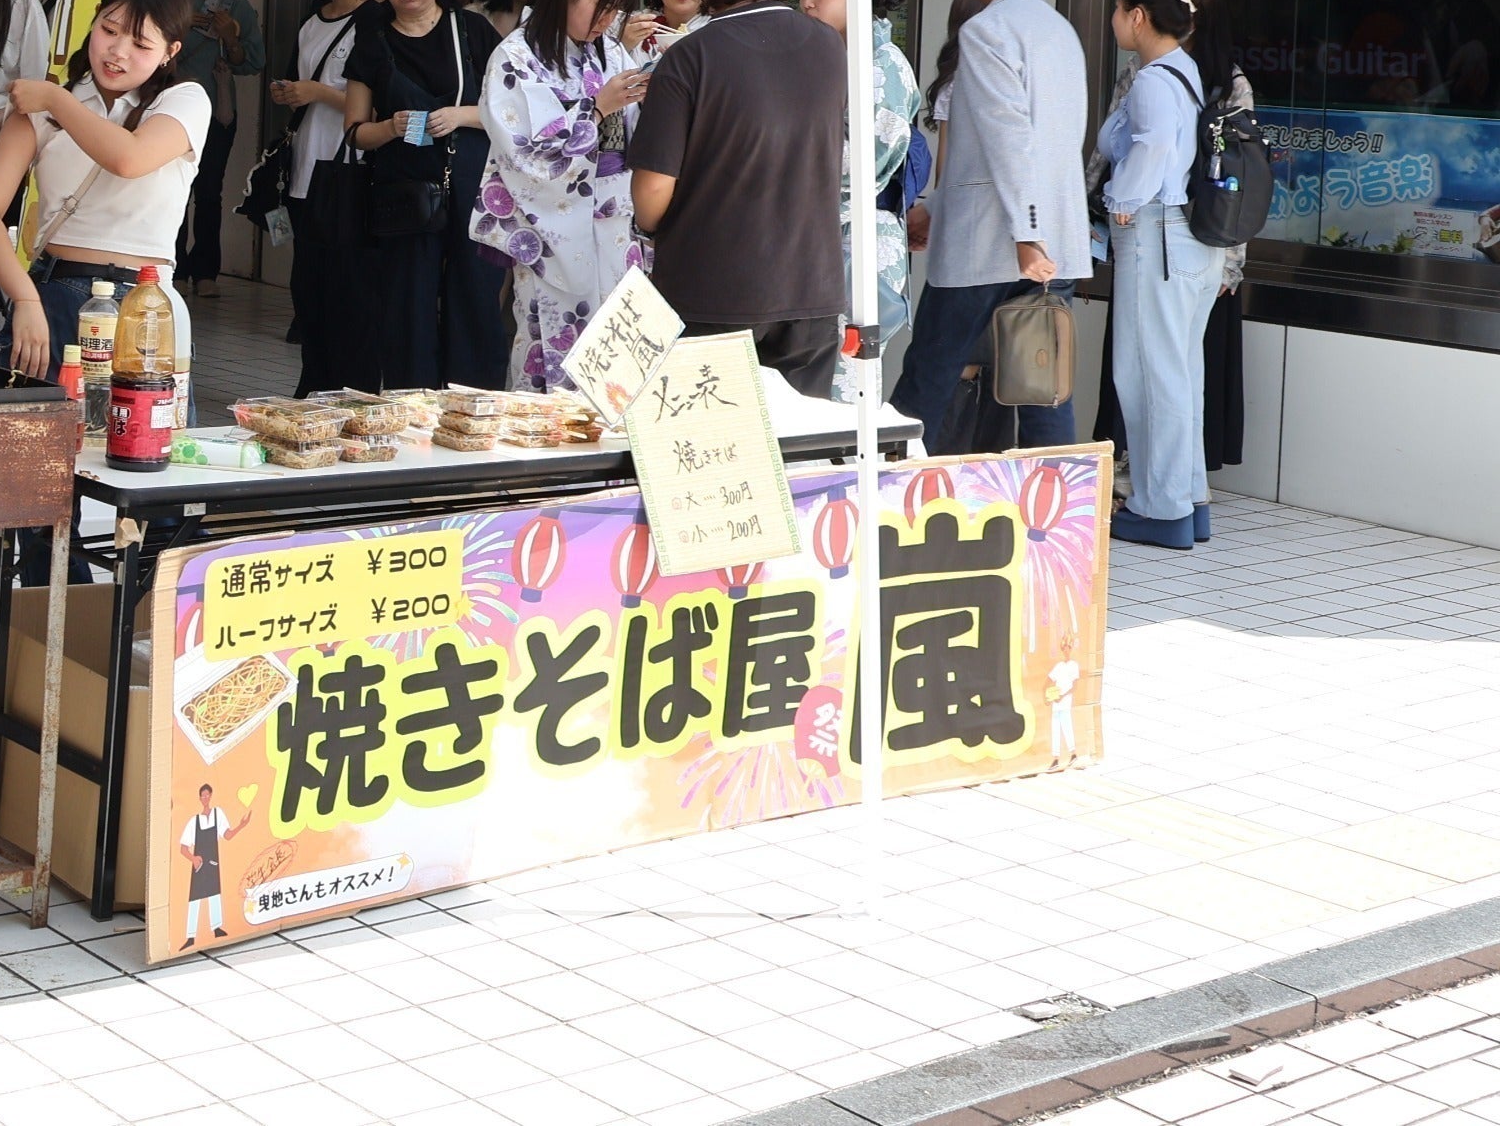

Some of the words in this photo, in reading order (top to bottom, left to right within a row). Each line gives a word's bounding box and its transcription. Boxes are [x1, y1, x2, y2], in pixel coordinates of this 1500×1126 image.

[1317, 42, 1428, 78] Guitar
[1258, 125, 1384, 153] 楽しみましょう!!
[578, 290, 643, 393] 焼きそば
[220, 553, 335, 599] 通常サイズ
[366, 545, 448, 575] ¥300
[214, 603, 339, 652] ハーフサイズ
[371, 593, 451, 626] ¥200
[277, 590, 816, 824] 焼きそば屋
[850, 511, 1026, 766] 嵐
